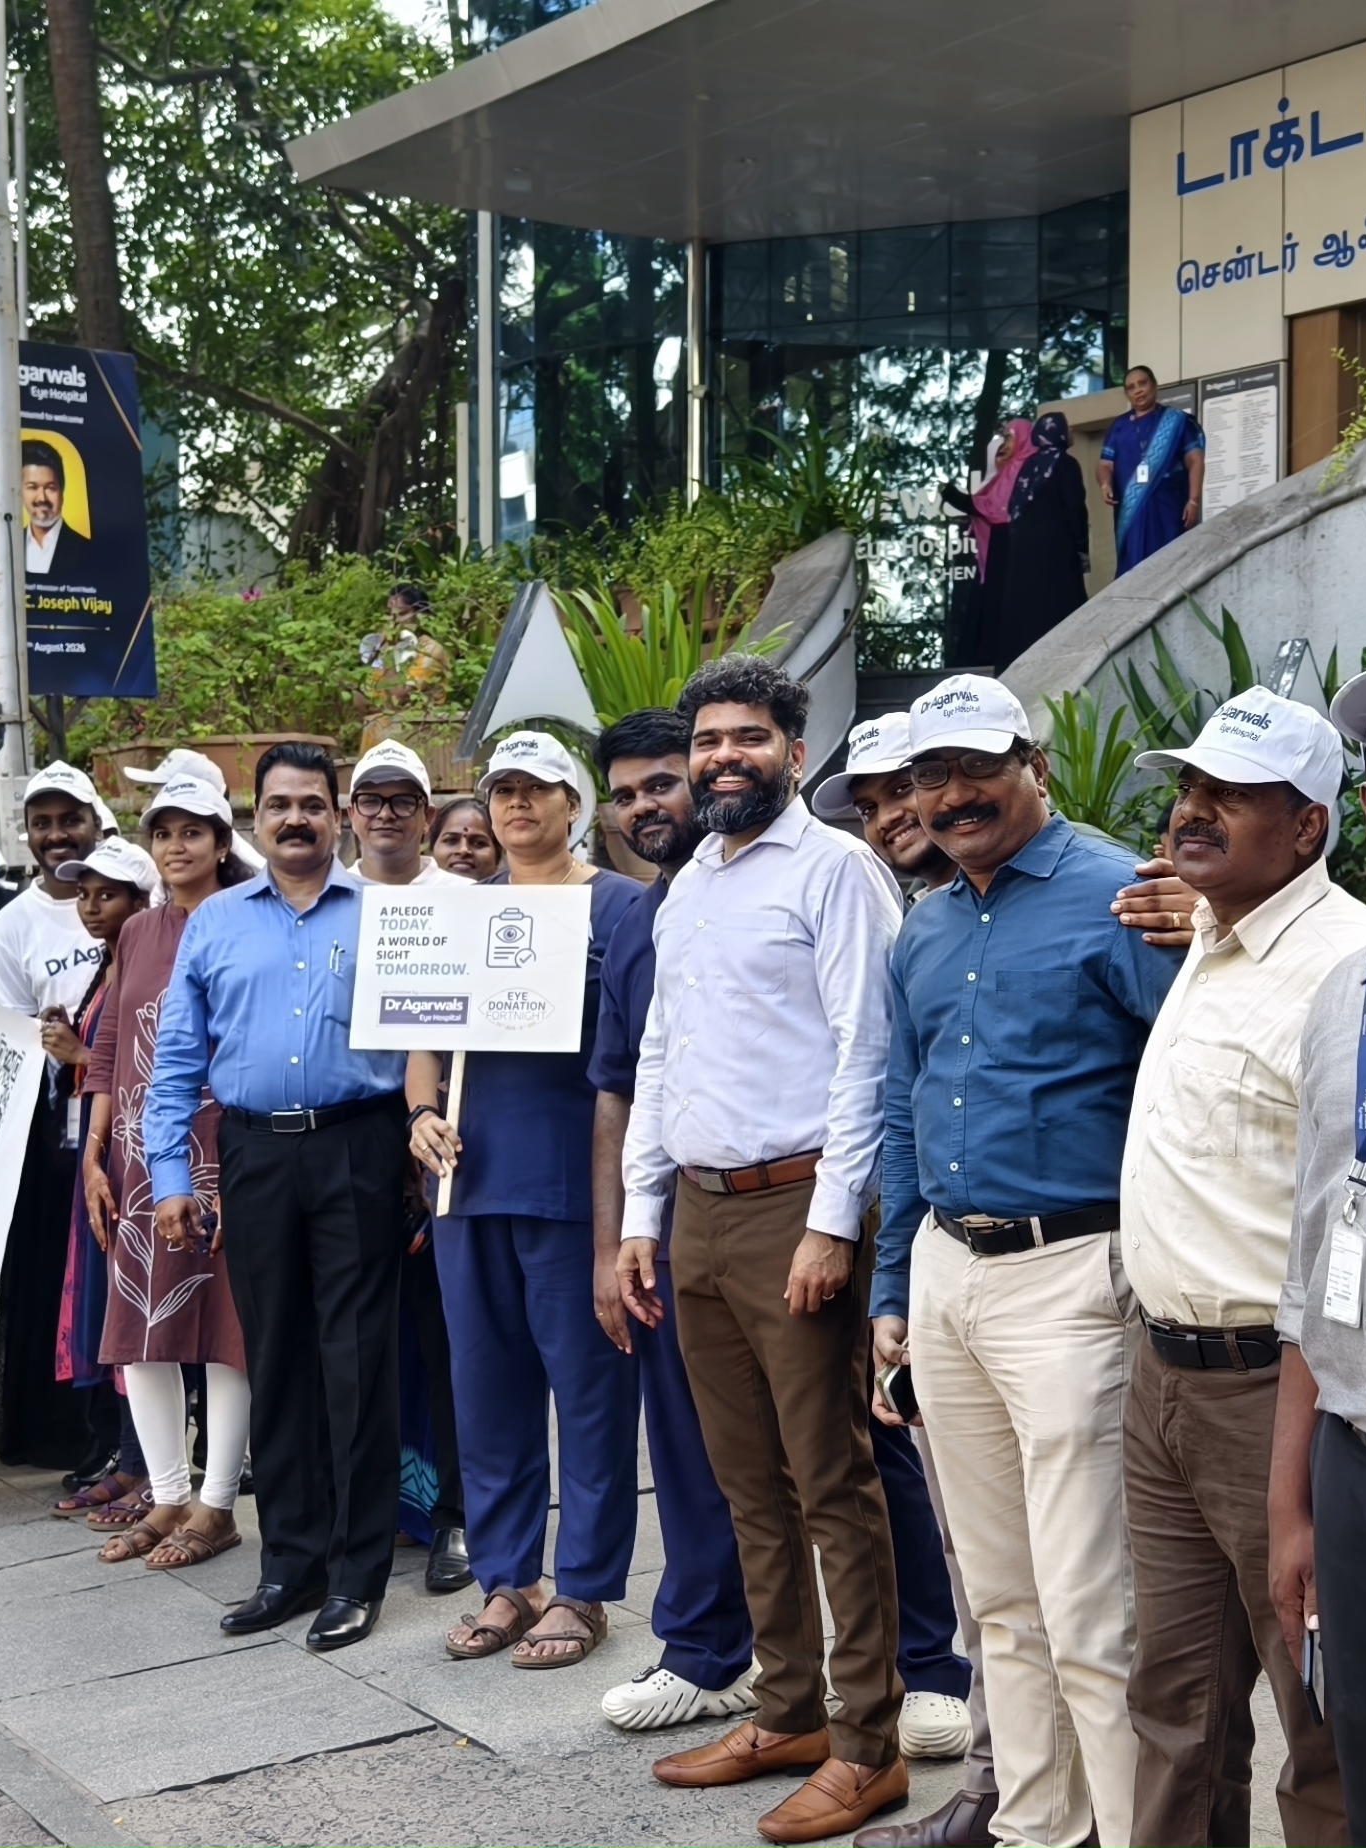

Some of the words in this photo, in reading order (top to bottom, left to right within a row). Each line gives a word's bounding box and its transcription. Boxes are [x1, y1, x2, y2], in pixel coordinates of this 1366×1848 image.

[1176, 232, 1300, 295] சென்டர்
[18, 364, 86, 388] garwals
[30, 385, 49, 401] Eye
[37, 595, 80, 613] Joseph
[80, 596, 113, 614] Vijay
[930, 691, 979, 710] Agarwals
[1231, 726, 1261, 742] Hospital
[380, 907, 388, 916] A
[391, 906, 434, 916] PLEDGE
[379, 918, 432, 931] TODAY.
[377, 937, 385, 946] A
[388, 936, 430, 946] WORLD
[432, 936, 448, 946] OF
[376, 950, 410, 960] SIGHT
[44, 954, 69, 977] Dr
[375, 963, 470, 976] TOMORROW.
[507, 992, 528, 1001] EYE
[385, 998, 401, 1011] Dr
[401, 997, 463, 1014] Agarwals
[488, 1001, 546, 1011] DONATION
[419, 1013, 432, 1022] Eye
[432, 1013, 462, 1022] Hospital
[486, 1011, 547, 1021] FORTNIGHT
